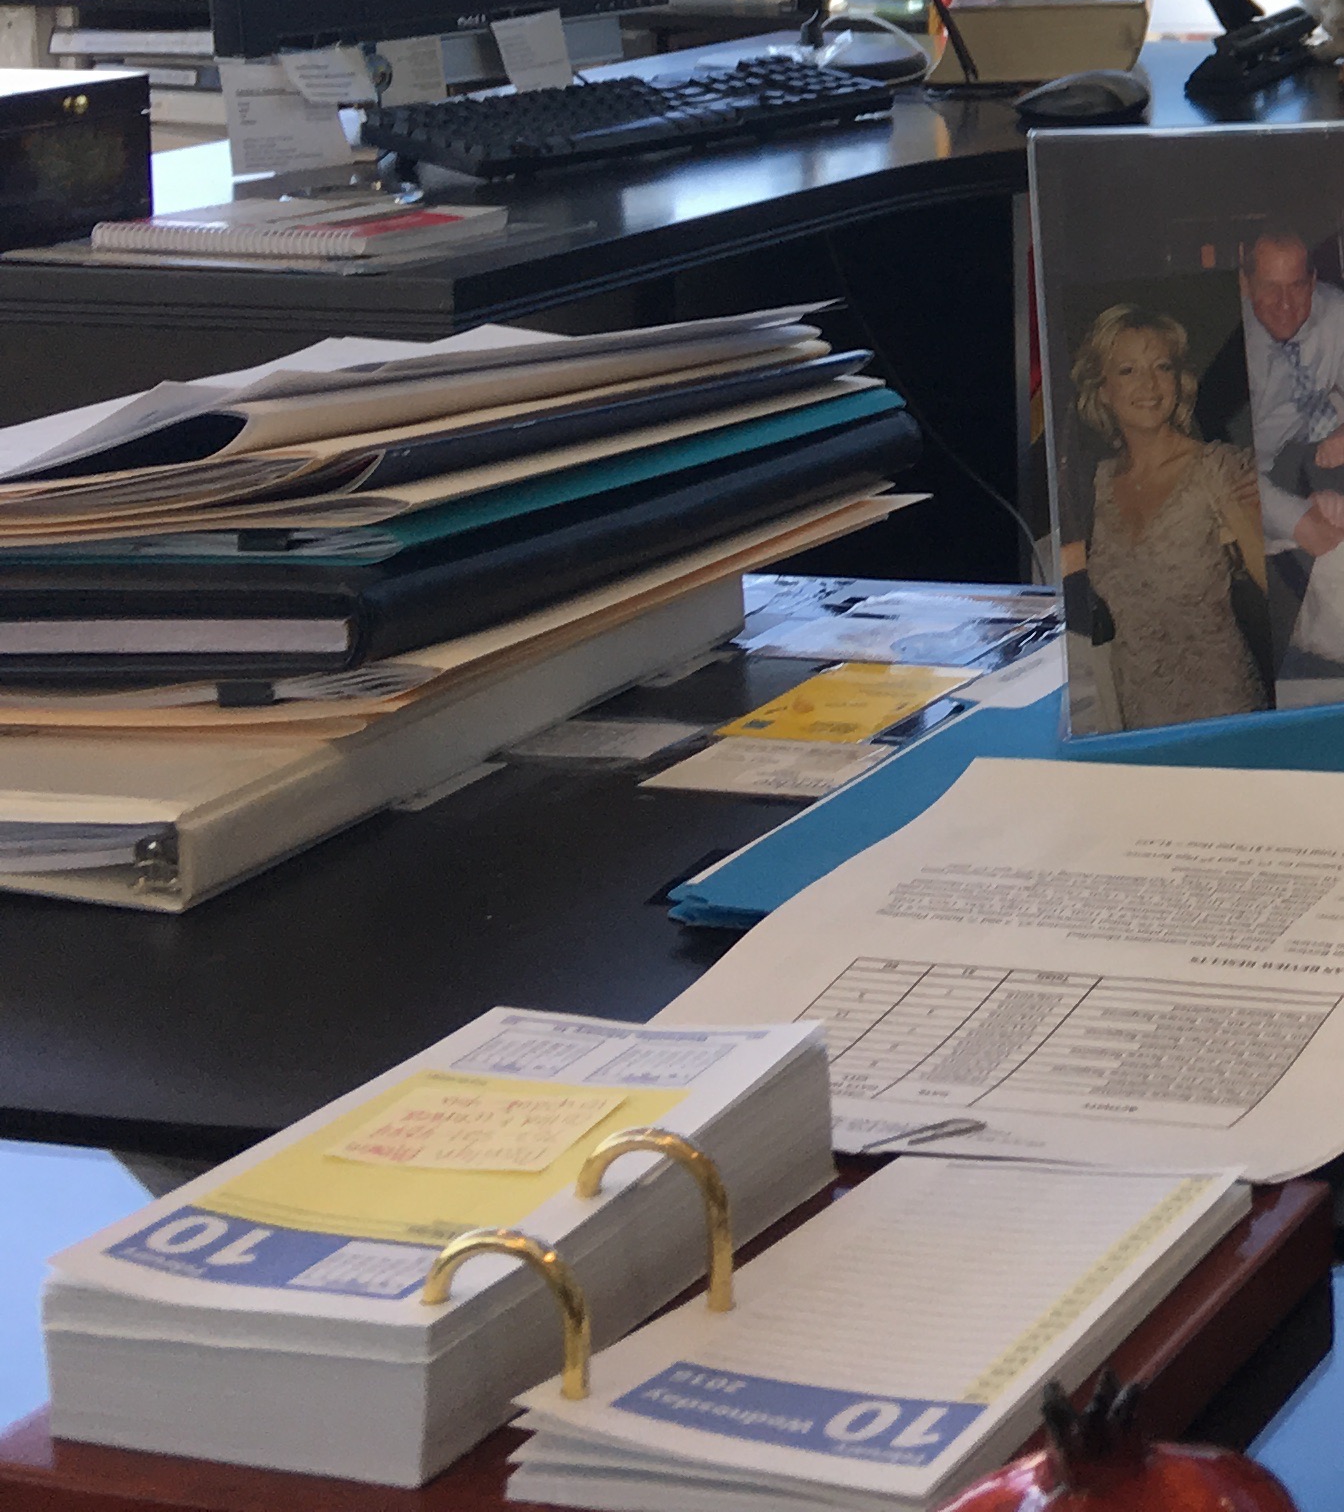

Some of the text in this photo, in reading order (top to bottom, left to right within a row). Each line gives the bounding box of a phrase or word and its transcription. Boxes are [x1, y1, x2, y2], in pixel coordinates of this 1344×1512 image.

[145, 1214, 274, 1267] 10
[641, 1388, 950, 1449] 10 Wednesday
